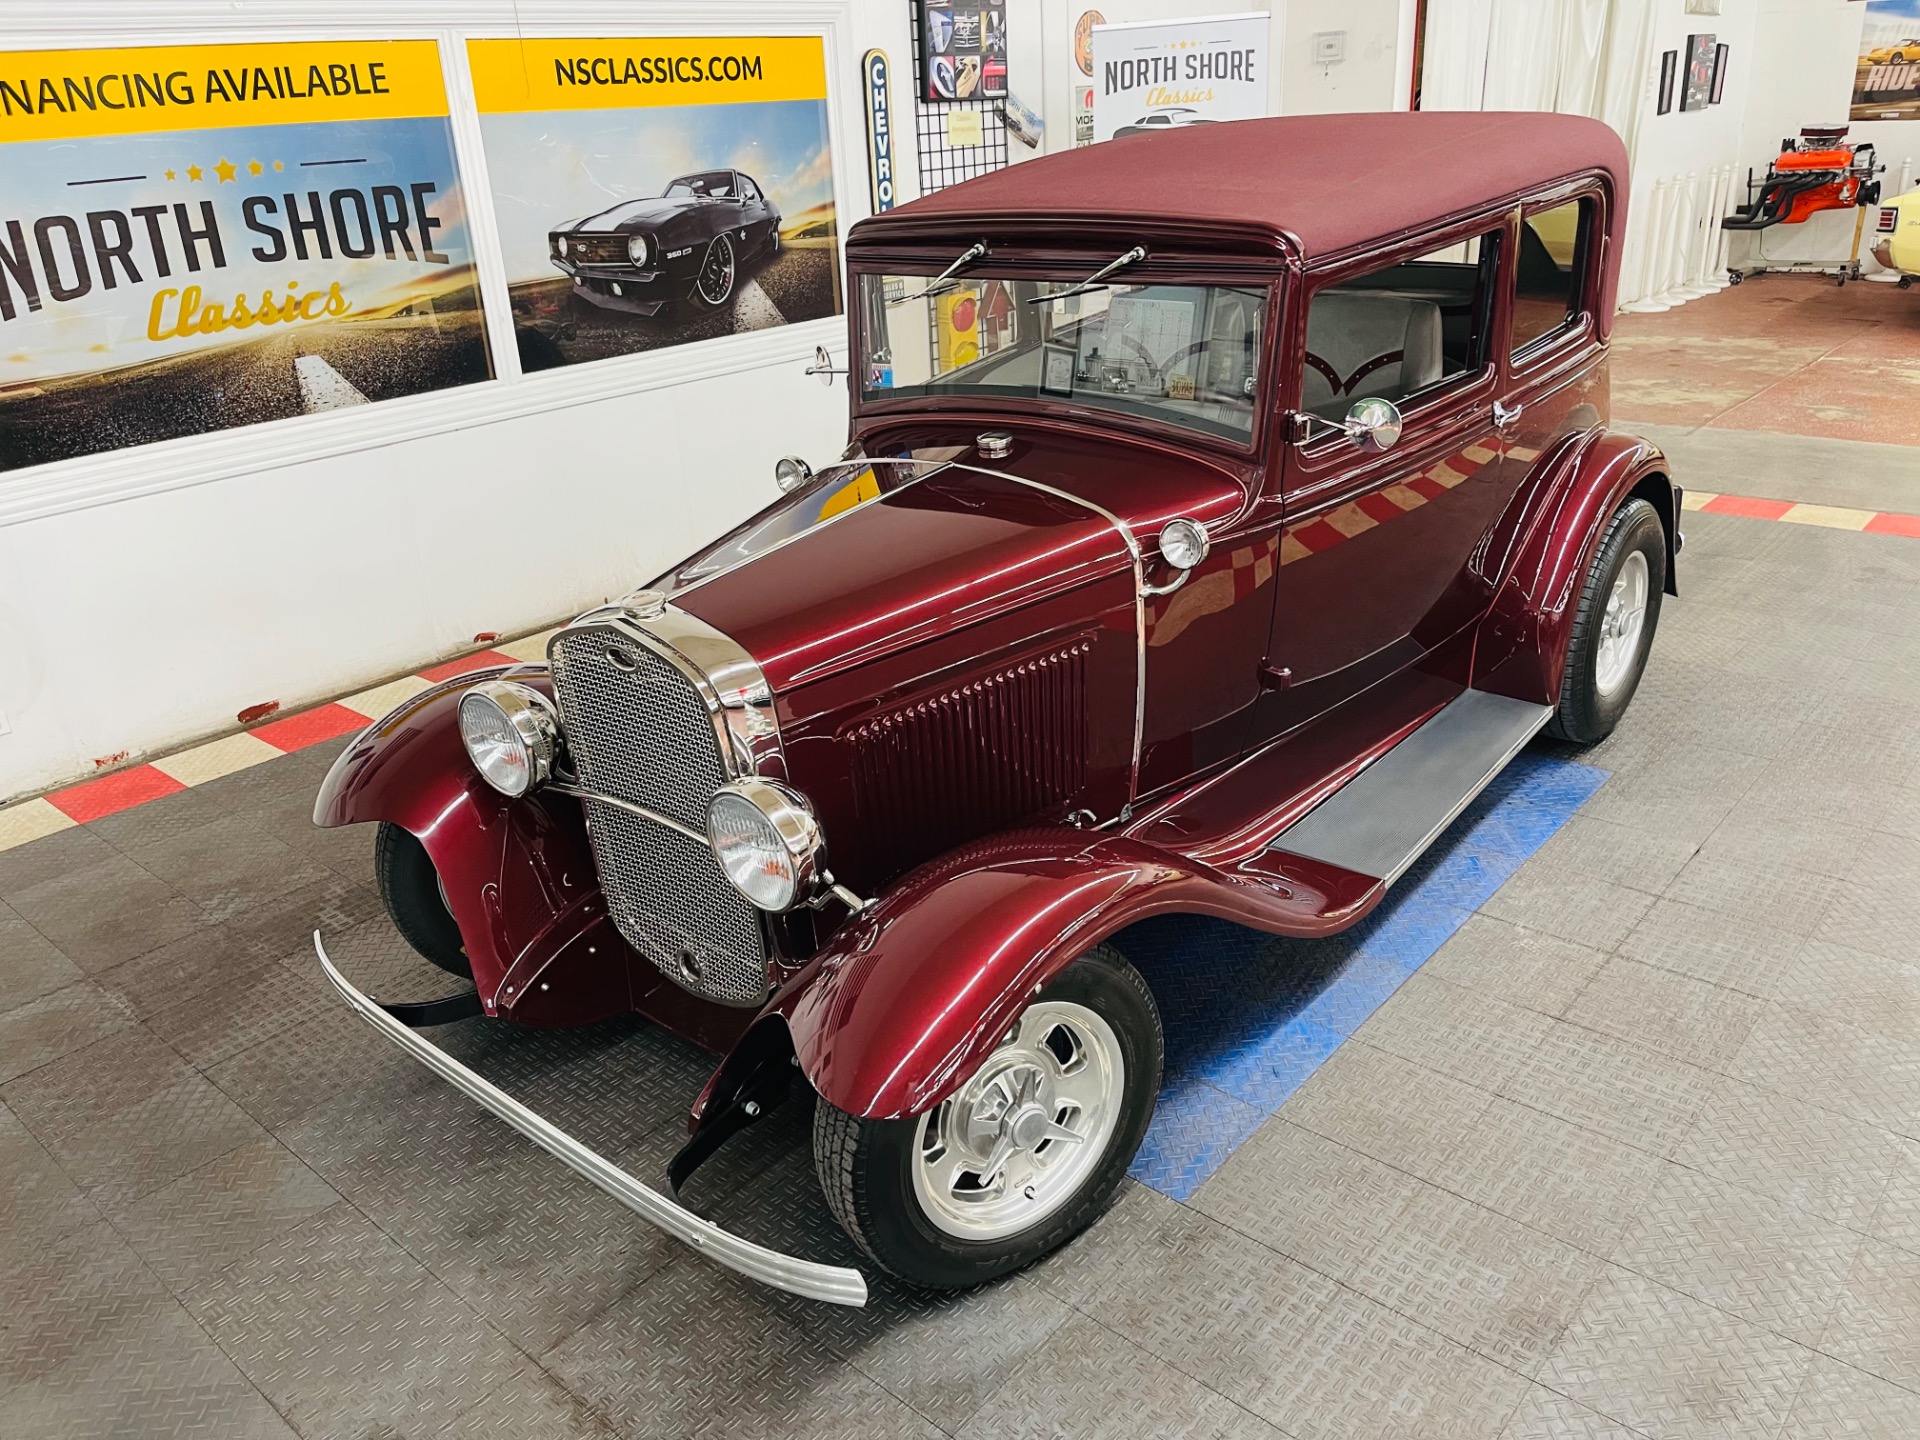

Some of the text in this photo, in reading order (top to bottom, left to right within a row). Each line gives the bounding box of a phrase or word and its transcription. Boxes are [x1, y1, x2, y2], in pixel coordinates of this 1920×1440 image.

[205, 62, 390, 103] AVAILABLE
[554, 55, 763, 86] NSCLASSICS.COM
[1105, 48, 1256, 96] NORTH SHORE
[1864, 64, 1920, 92] RIDE
[1145, 86, 1215, 107] Classics
[0, 182, 450, 322] NORTH SHORE
[147, 280, 353, 342] Classics
